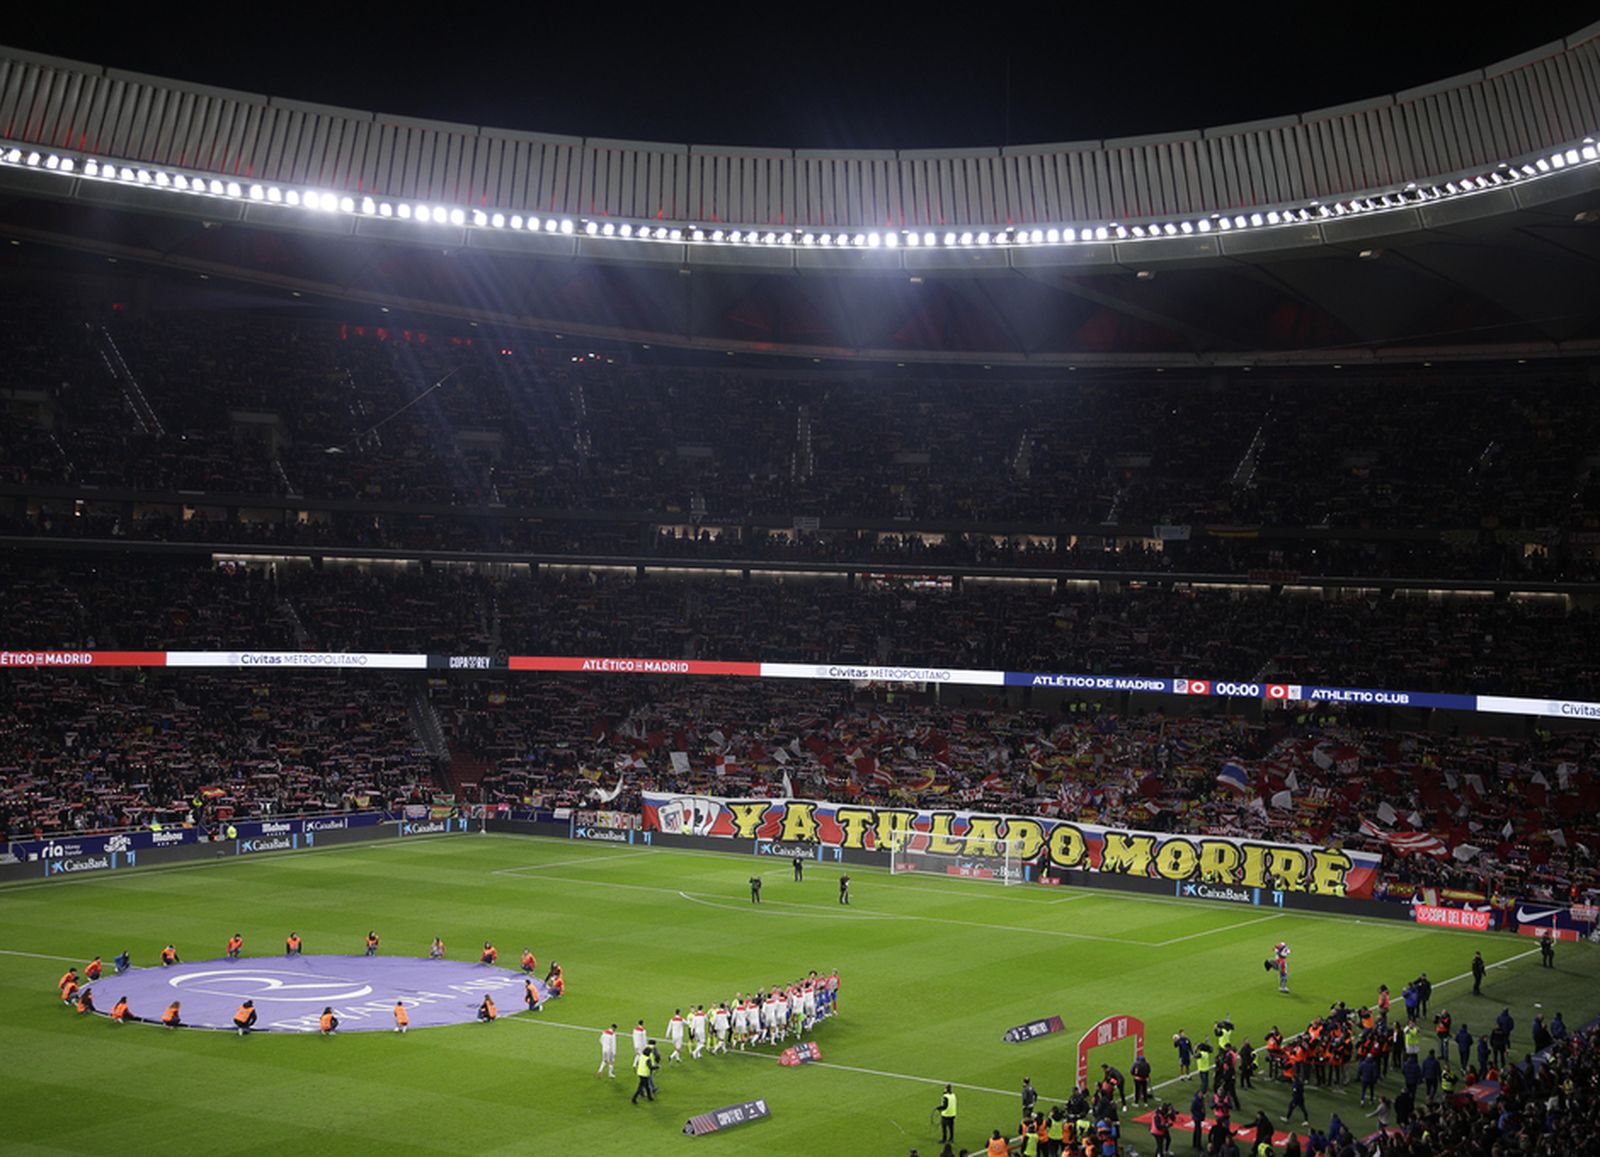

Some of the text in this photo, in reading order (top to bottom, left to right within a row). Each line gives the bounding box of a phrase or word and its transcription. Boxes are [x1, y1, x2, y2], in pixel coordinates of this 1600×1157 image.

[45, 653, 92, 664] MADRID
[284, 655, 368, 665] METROPOLITANO
[582, 659, 634, 671] ATLÉTICO
[644, 661, 689, 672] MADRID
[870, 669, 950, 680] METROPOLITANO
[1032, 675, 1165, 690] ATLÉTICO DE MADRID
[1216, 682, 1259, 697] 00:00
[1311, 689, 1409, 704] ATHLETIC CLUB
[412, 821, 445, 834] CaixaBank
[587, 828, 627, 841] CaixaBank
[725, 801, 772, 840] Y
[779, 801, 822, 844] A
[836, 807, 918, 851] TU
[928, 812, 1086, 868] LADO
[42, 840, 63, 858] ria
[252, 838, 291, 851] CaixaBank
[772, 844, 815, 858] CaixaBank
[64, 857, 109, 872] CaixaBank
[1198, 884, 1250, 902] CaixaBank
